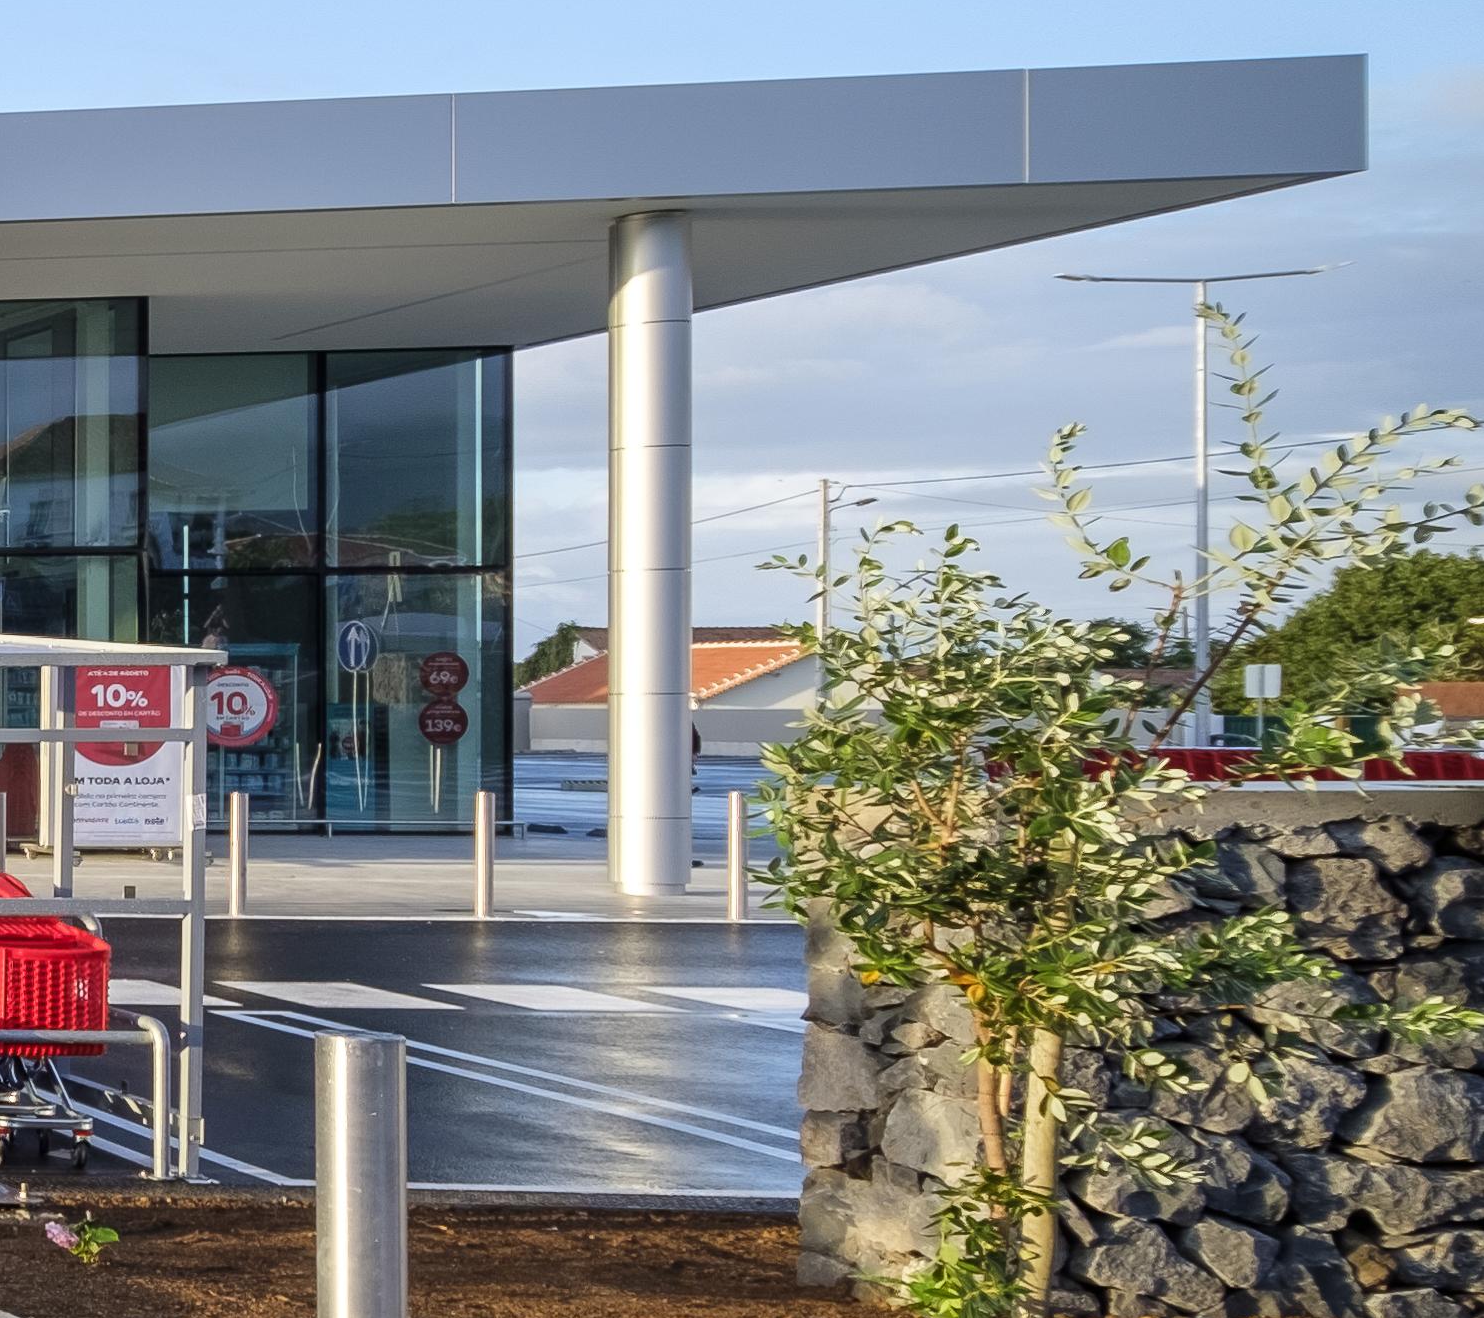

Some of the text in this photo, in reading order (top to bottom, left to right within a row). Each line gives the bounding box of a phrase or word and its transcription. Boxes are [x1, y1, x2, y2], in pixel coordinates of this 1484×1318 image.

[90, 683, 149, 708] 10%
[210, 691, 256, 716] 10%
[74, 777, 85, 785] M
[87, 777, 120, 785] TODA
[123, 777, 133, 785] A
